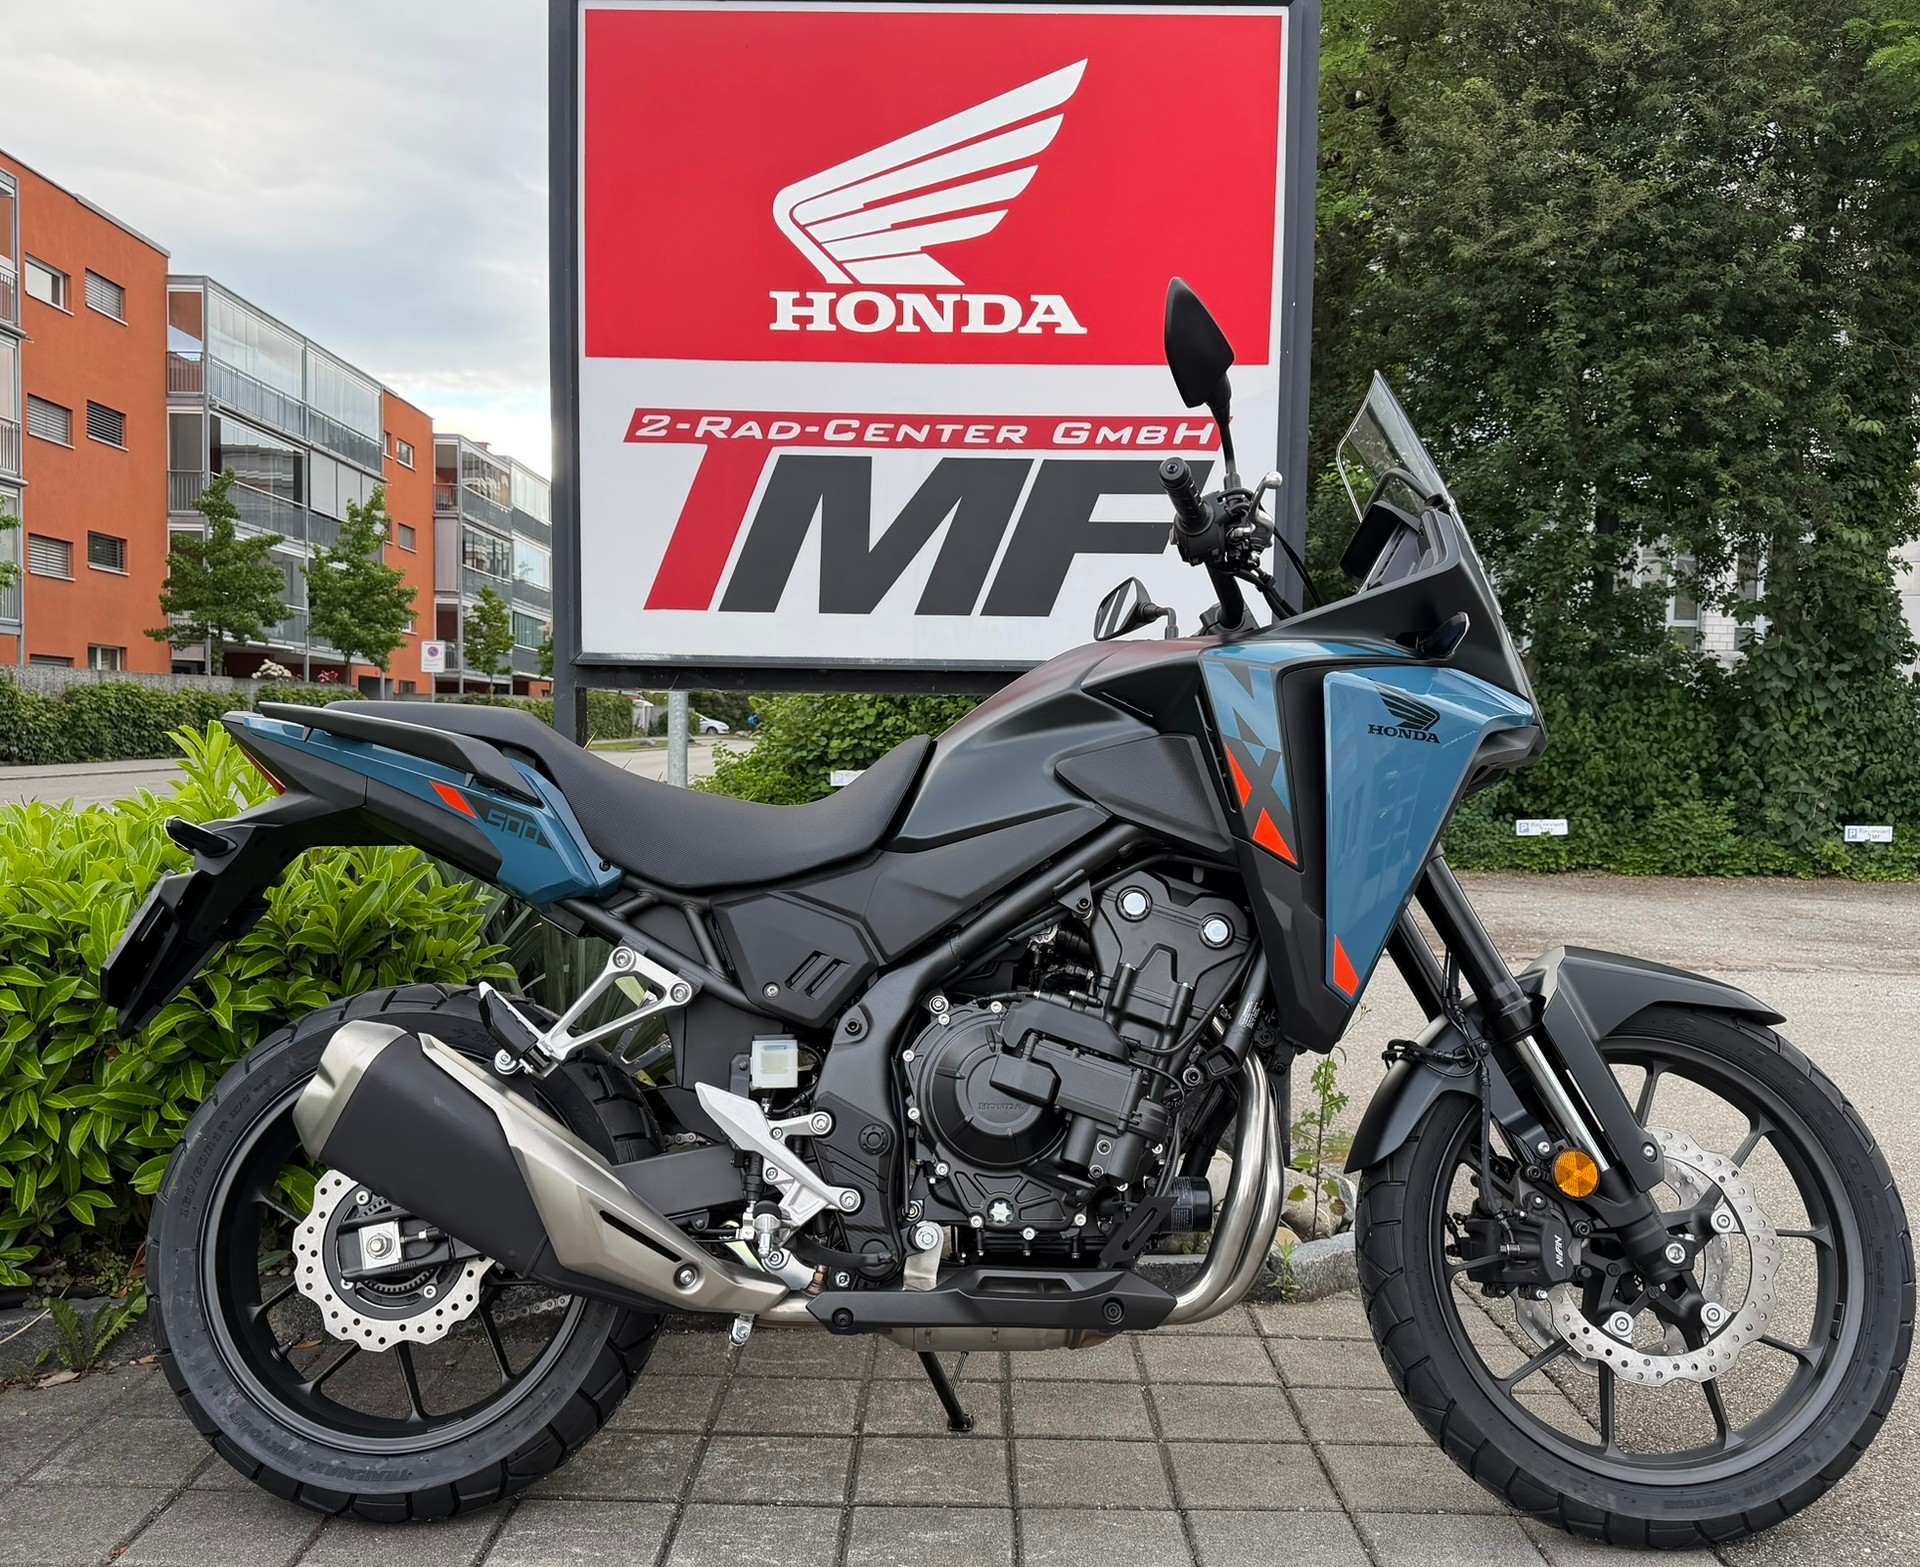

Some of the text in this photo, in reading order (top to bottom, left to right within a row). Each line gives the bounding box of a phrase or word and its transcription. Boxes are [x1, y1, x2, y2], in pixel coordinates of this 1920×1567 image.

[769, 290, 1088, 335] HONDA
[624, 408, 1216, 617] TMF
[1367, 723, 1441, 745] HONDA
[486, 808, 541, 845] 500
[977, 1102, 1025, 1111] HONDA
